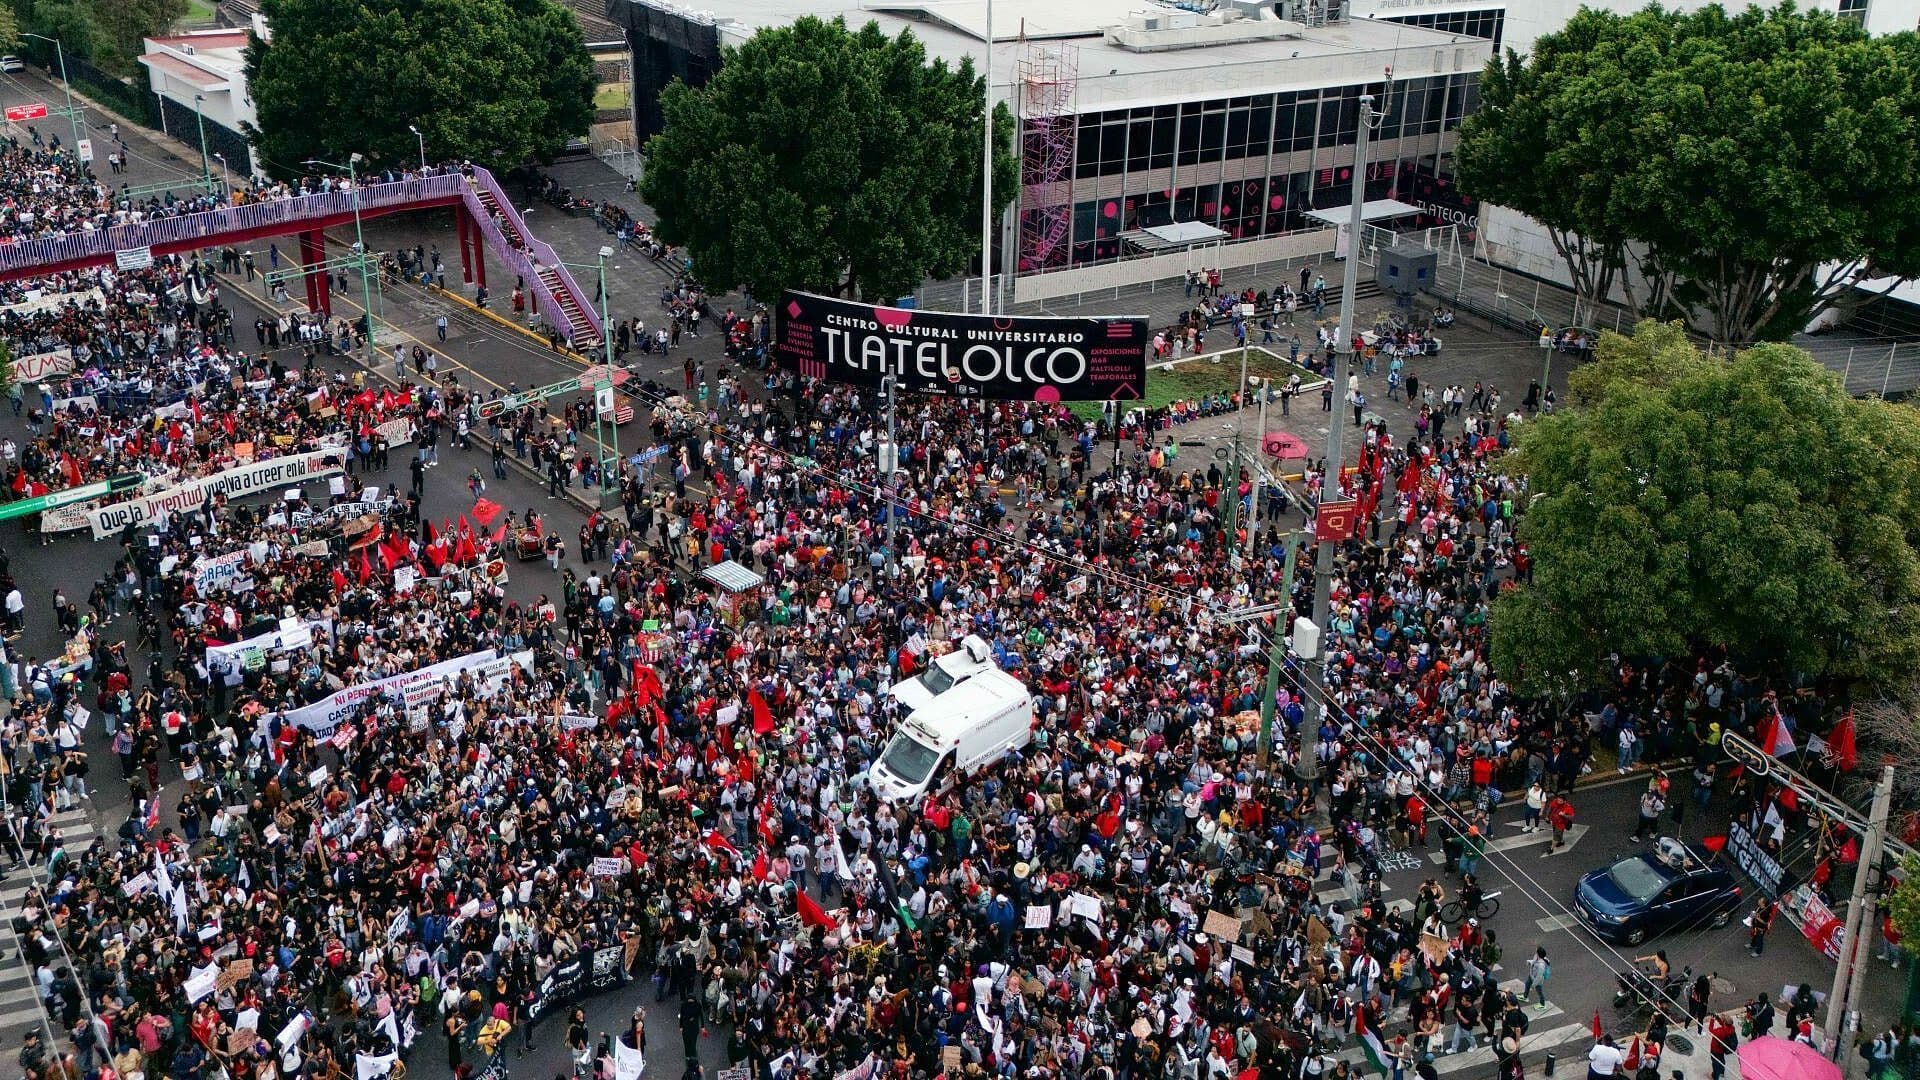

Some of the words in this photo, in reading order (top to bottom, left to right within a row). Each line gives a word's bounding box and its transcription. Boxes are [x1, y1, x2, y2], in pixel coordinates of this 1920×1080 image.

[827, 314, 878, 331] CENTRO
[885, 323, 958, 339] CULTURAL
[967, 330, 1084, 343] UNIVERSITARIO
[820, 327, 1086, 385] TLATELOLCO
[100, 509, 127, 531] Que
[129, 504, 144, 522] la
[204, 474, 242, 500] vuelva
[243, 473, 251, 489] a
[252, 465, 284, 486] creer
[335, 696, 346, 706] NI
[1735, 826, 1751, 850] DE
